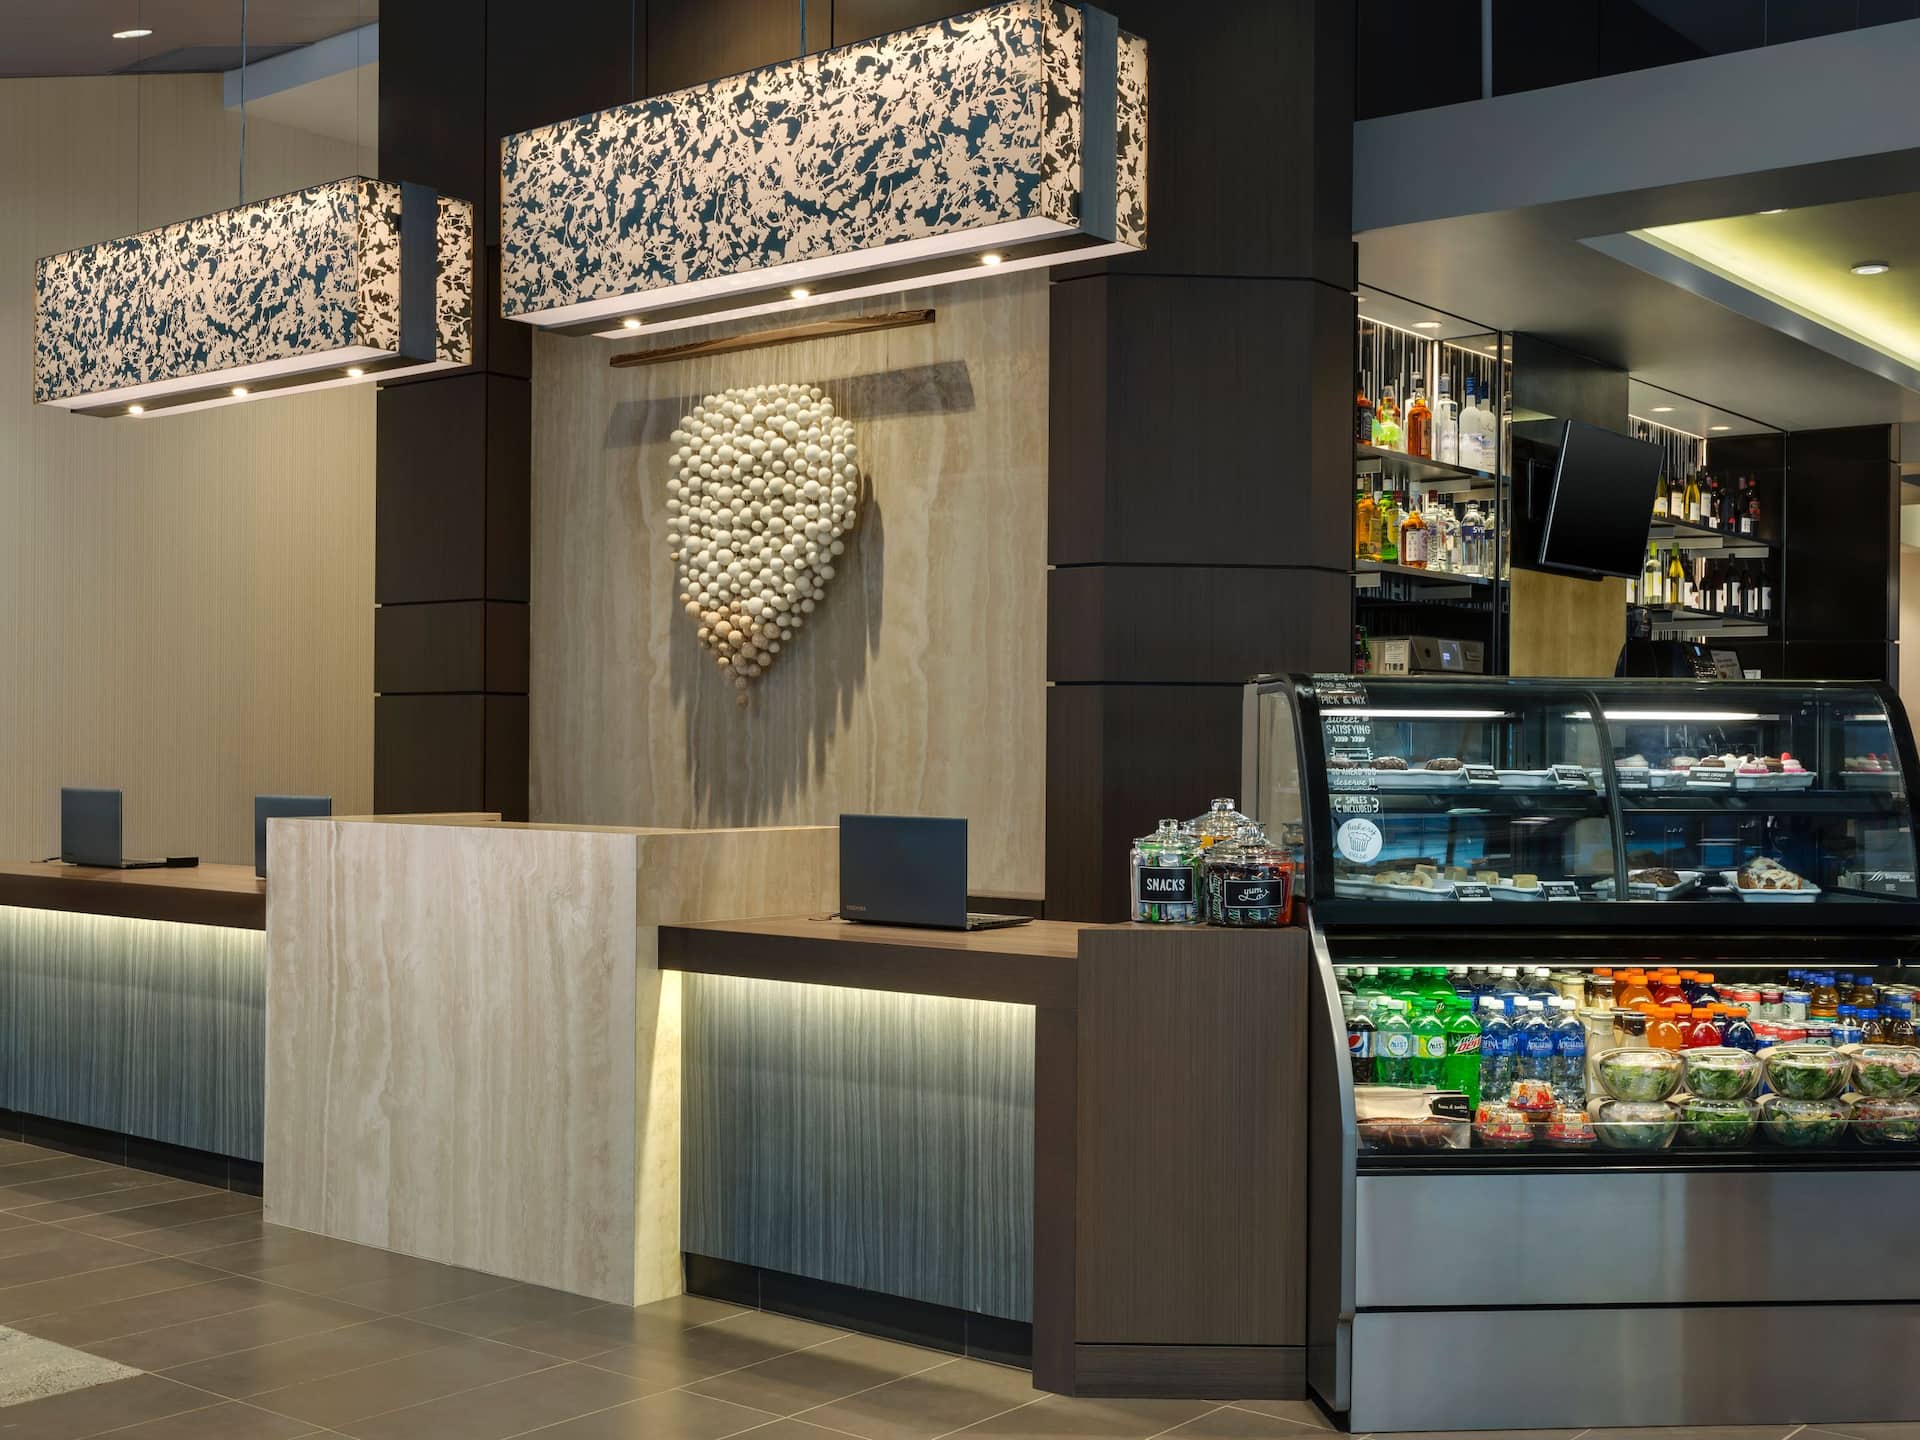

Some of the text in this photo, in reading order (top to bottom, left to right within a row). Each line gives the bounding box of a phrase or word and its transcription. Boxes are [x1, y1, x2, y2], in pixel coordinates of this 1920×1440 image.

[1321, 696, 1366, 704] PICK & MIX
[1326, 725, 1371, 735] SATISFYING
[1333, 778, 1367, 786] deserve
[1345, 796, 1368, 804] SMILES
[1342, 804, 1372, 813] INCLUDED
[1347, 823, 1377, 836] bakery
[1146, 878, 1186, 892] SNACKS
[1239, 887, 1269, 901] yum
